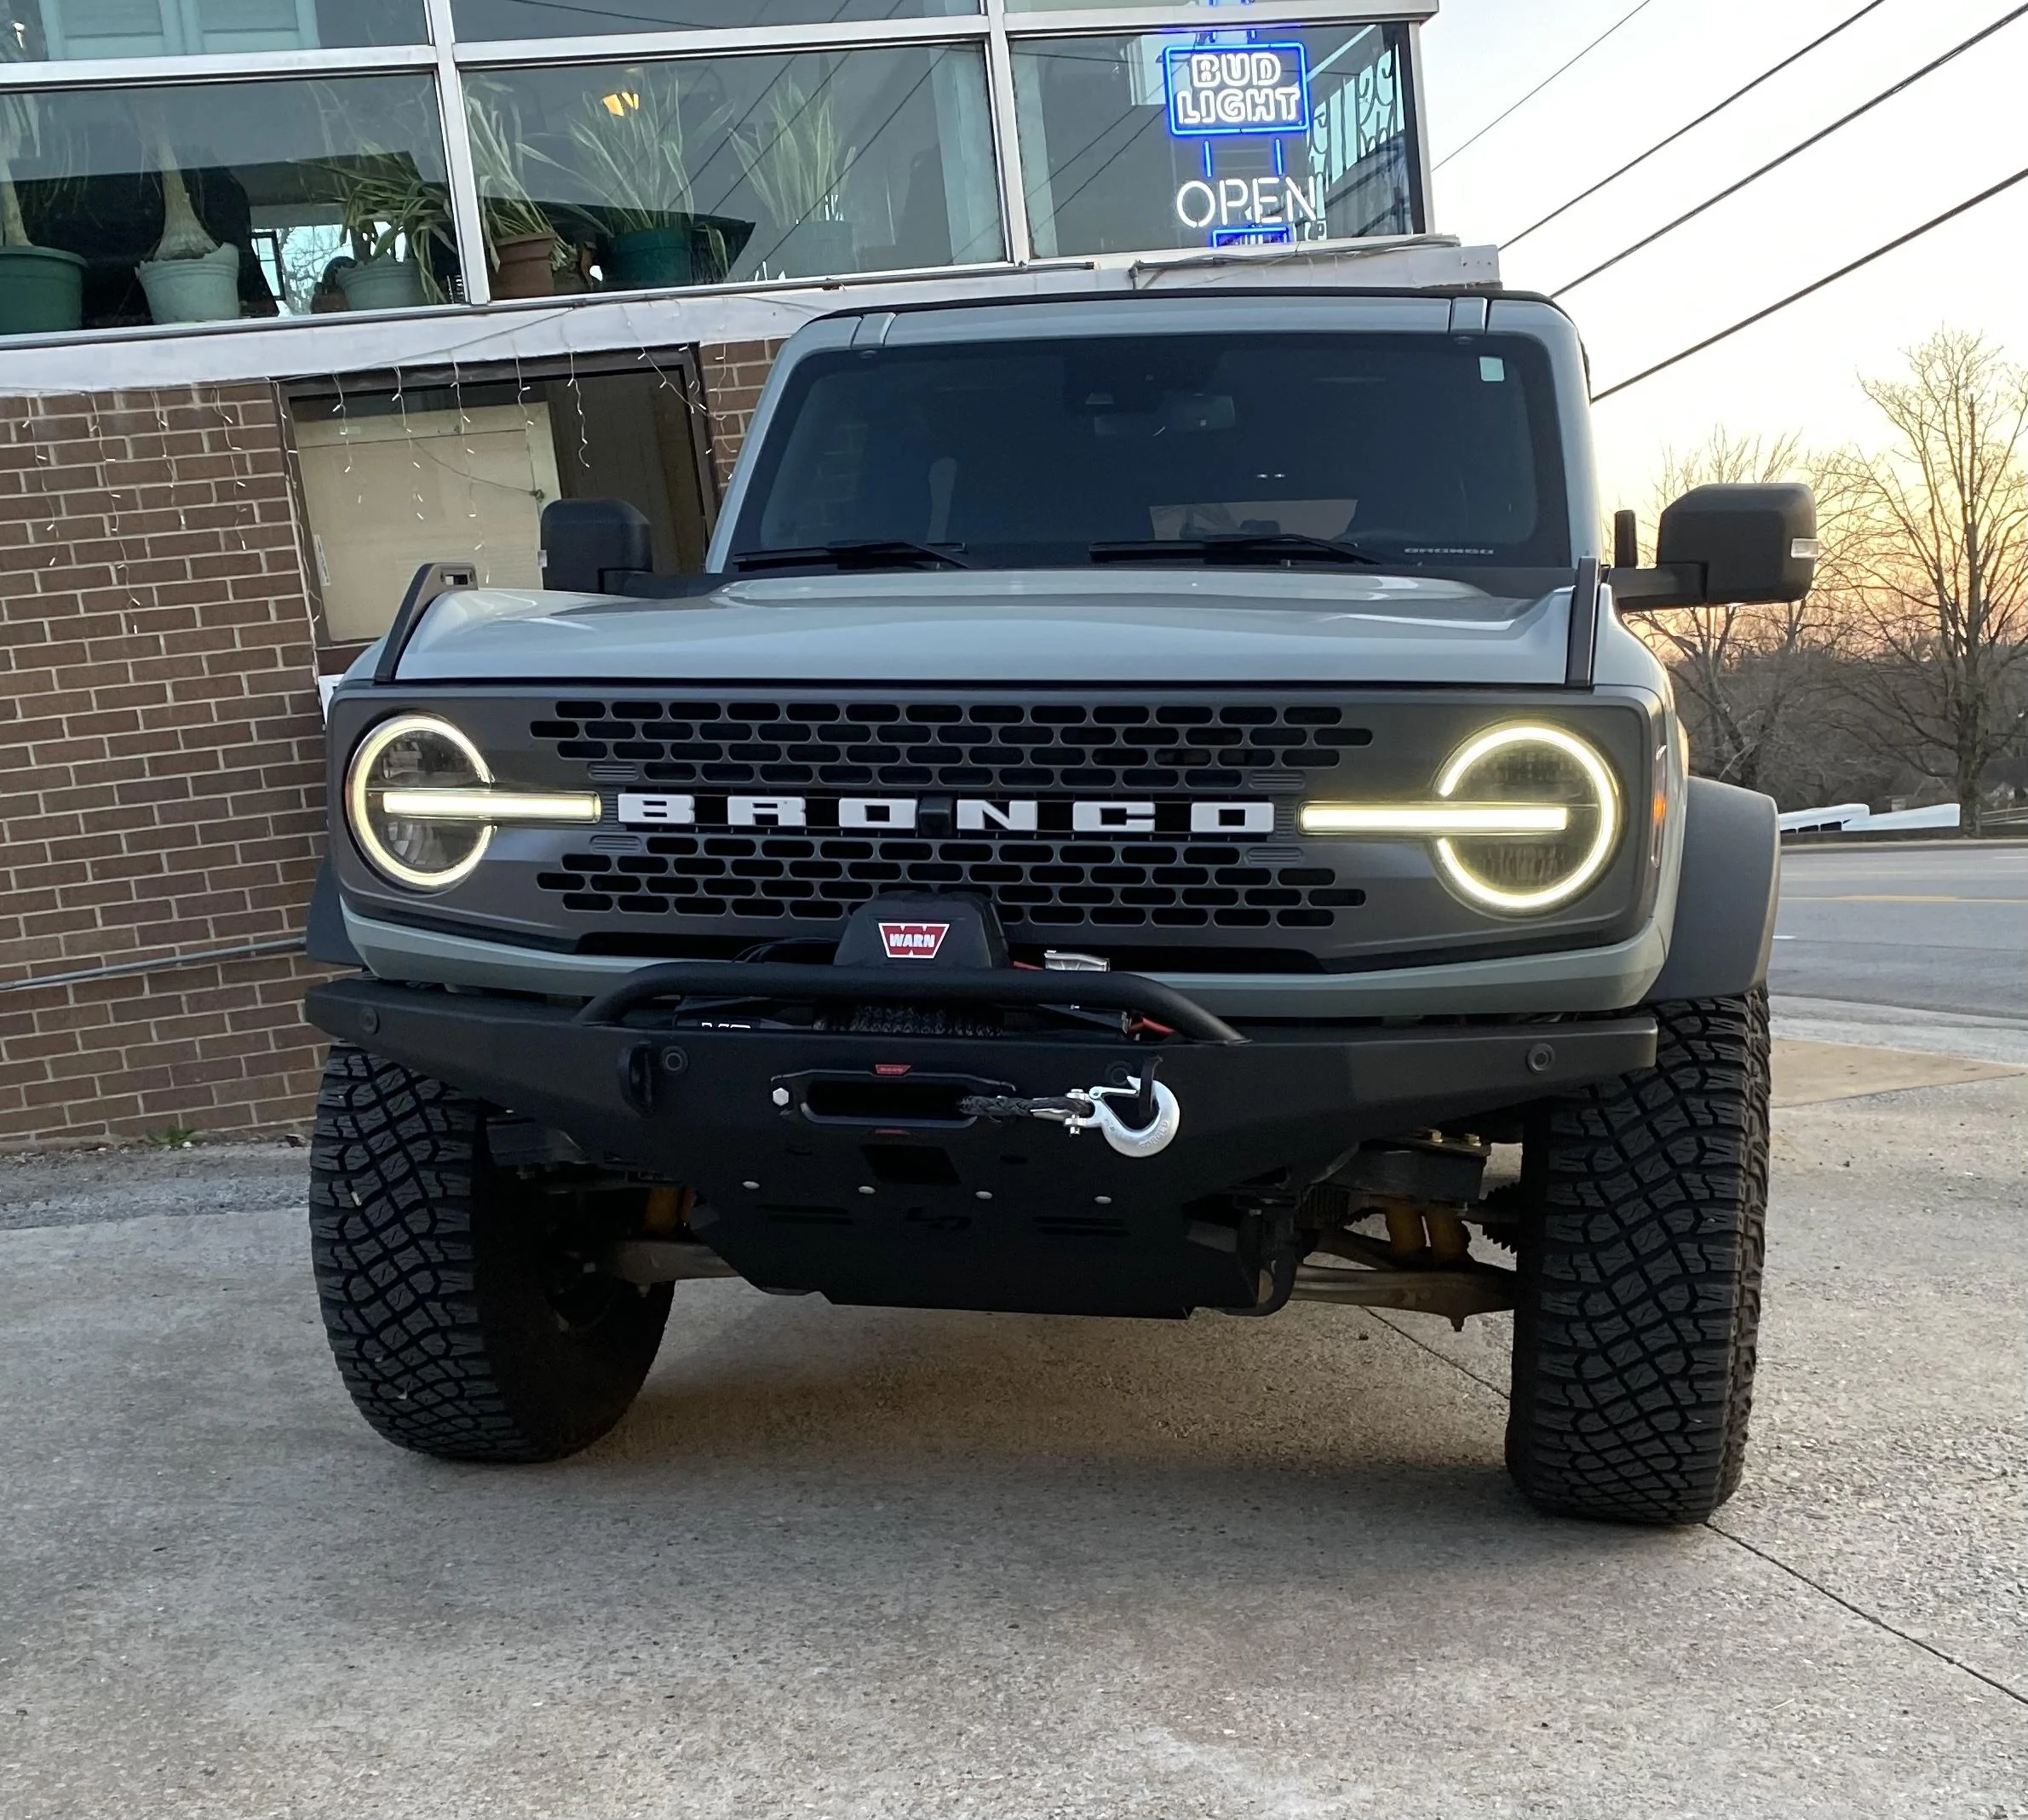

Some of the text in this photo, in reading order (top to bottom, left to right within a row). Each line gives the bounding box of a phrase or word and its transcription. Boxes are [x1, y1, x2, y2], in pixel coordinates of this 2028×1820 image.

[1190, 52, 1281, 88] BUD
[1176, 86, 1301, 124] LIGHT
[1175, 175, 1317, 228] OPEN
[618, 793, 1275, 834] BRONCO
[889, 933, 935, 948] WARN
